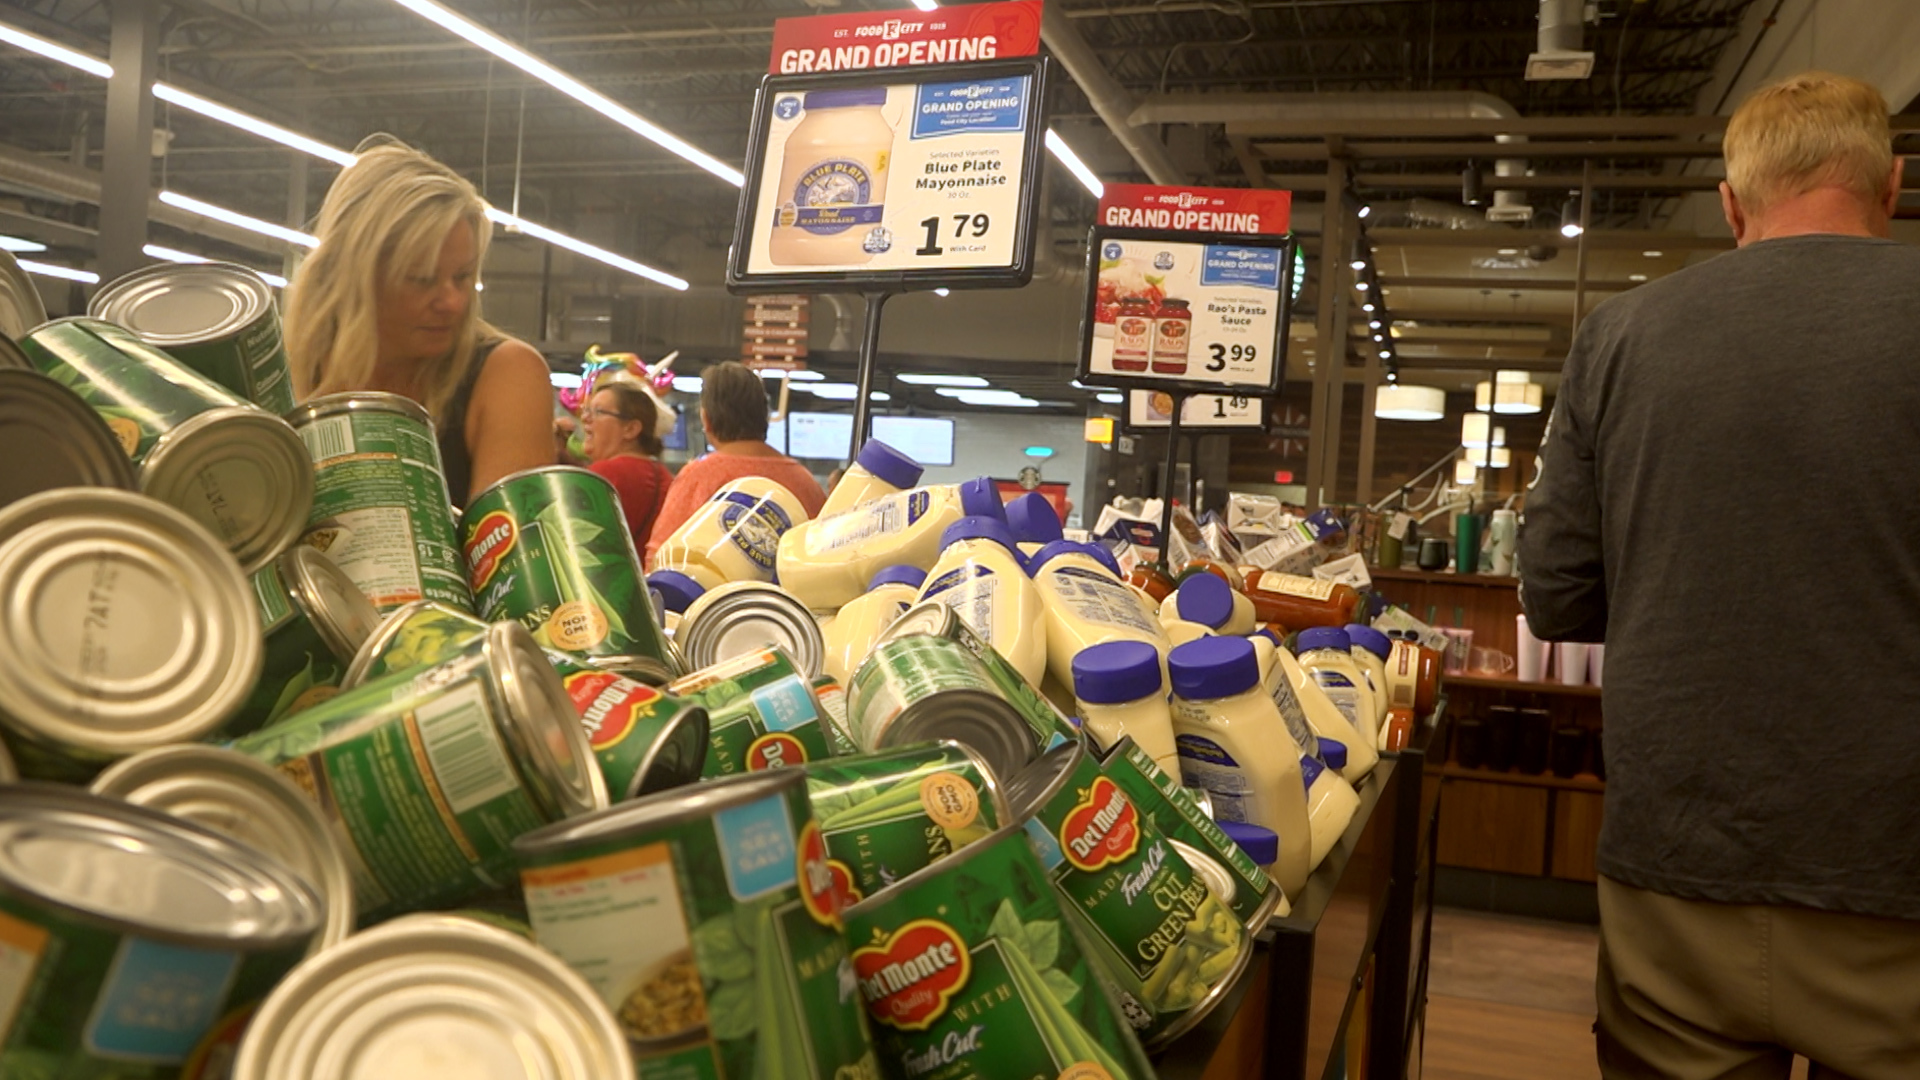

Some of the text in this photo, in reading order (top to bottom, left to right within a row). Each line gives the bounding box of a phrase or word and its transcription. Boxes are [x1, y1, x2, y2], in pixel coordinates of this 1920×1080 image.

[854, 24, 884, 37] FOOD
[900, 22, 925, 34] CITY
[780, 35, 997, 75] GRAND OPENING
[782, 107, 791, 118] 2
[922, 96, 1019, 114] GRAND OPENING
[925, 159, 1002, 175] Blue Plate
[930, 150, 964, 159] Selected
[802, 163, 867, 187] BLUE PLATE
[915, 174, 1007, 191] Mayonnaise
[953, 213, 990, 238] 79
[1106, 206, 1260, 234] GRAND OPENING
[1207, 259, 1276, 271] GRAND OPENING
[1207, 303, 1267, 315] Rao's Pasta
[1220, 314, 1252, 325] Sauce
[1205, 343, 1256, 372] 3 99
[470, 522, 511, 566] Monte
[500, 547, 541, 576] WITH
[711, 735, 734, 773] MAD
[762, 741, 785, 770] De
[936, 786, 954, 814] NON
[945, 784, 962, 813] GMO
[1070, 823, 1104, 859] Del
[856, 834, 874, 886] WITH
[1120, 862, 1155, 907] Fresh
[1148, 840, 1167, 872] Cut
[1085, 868, 1125, 910] MADE
[1153, 872, 1185, 911] CUT
[1137, 904, 1191, 961] GREEN
[881, 941, 958, 993] Monte
[891, 989, 934, 1015] Quality
[953, 983, 1012, 1023] WITH
[942, 1024, 984, 1063] Cut
